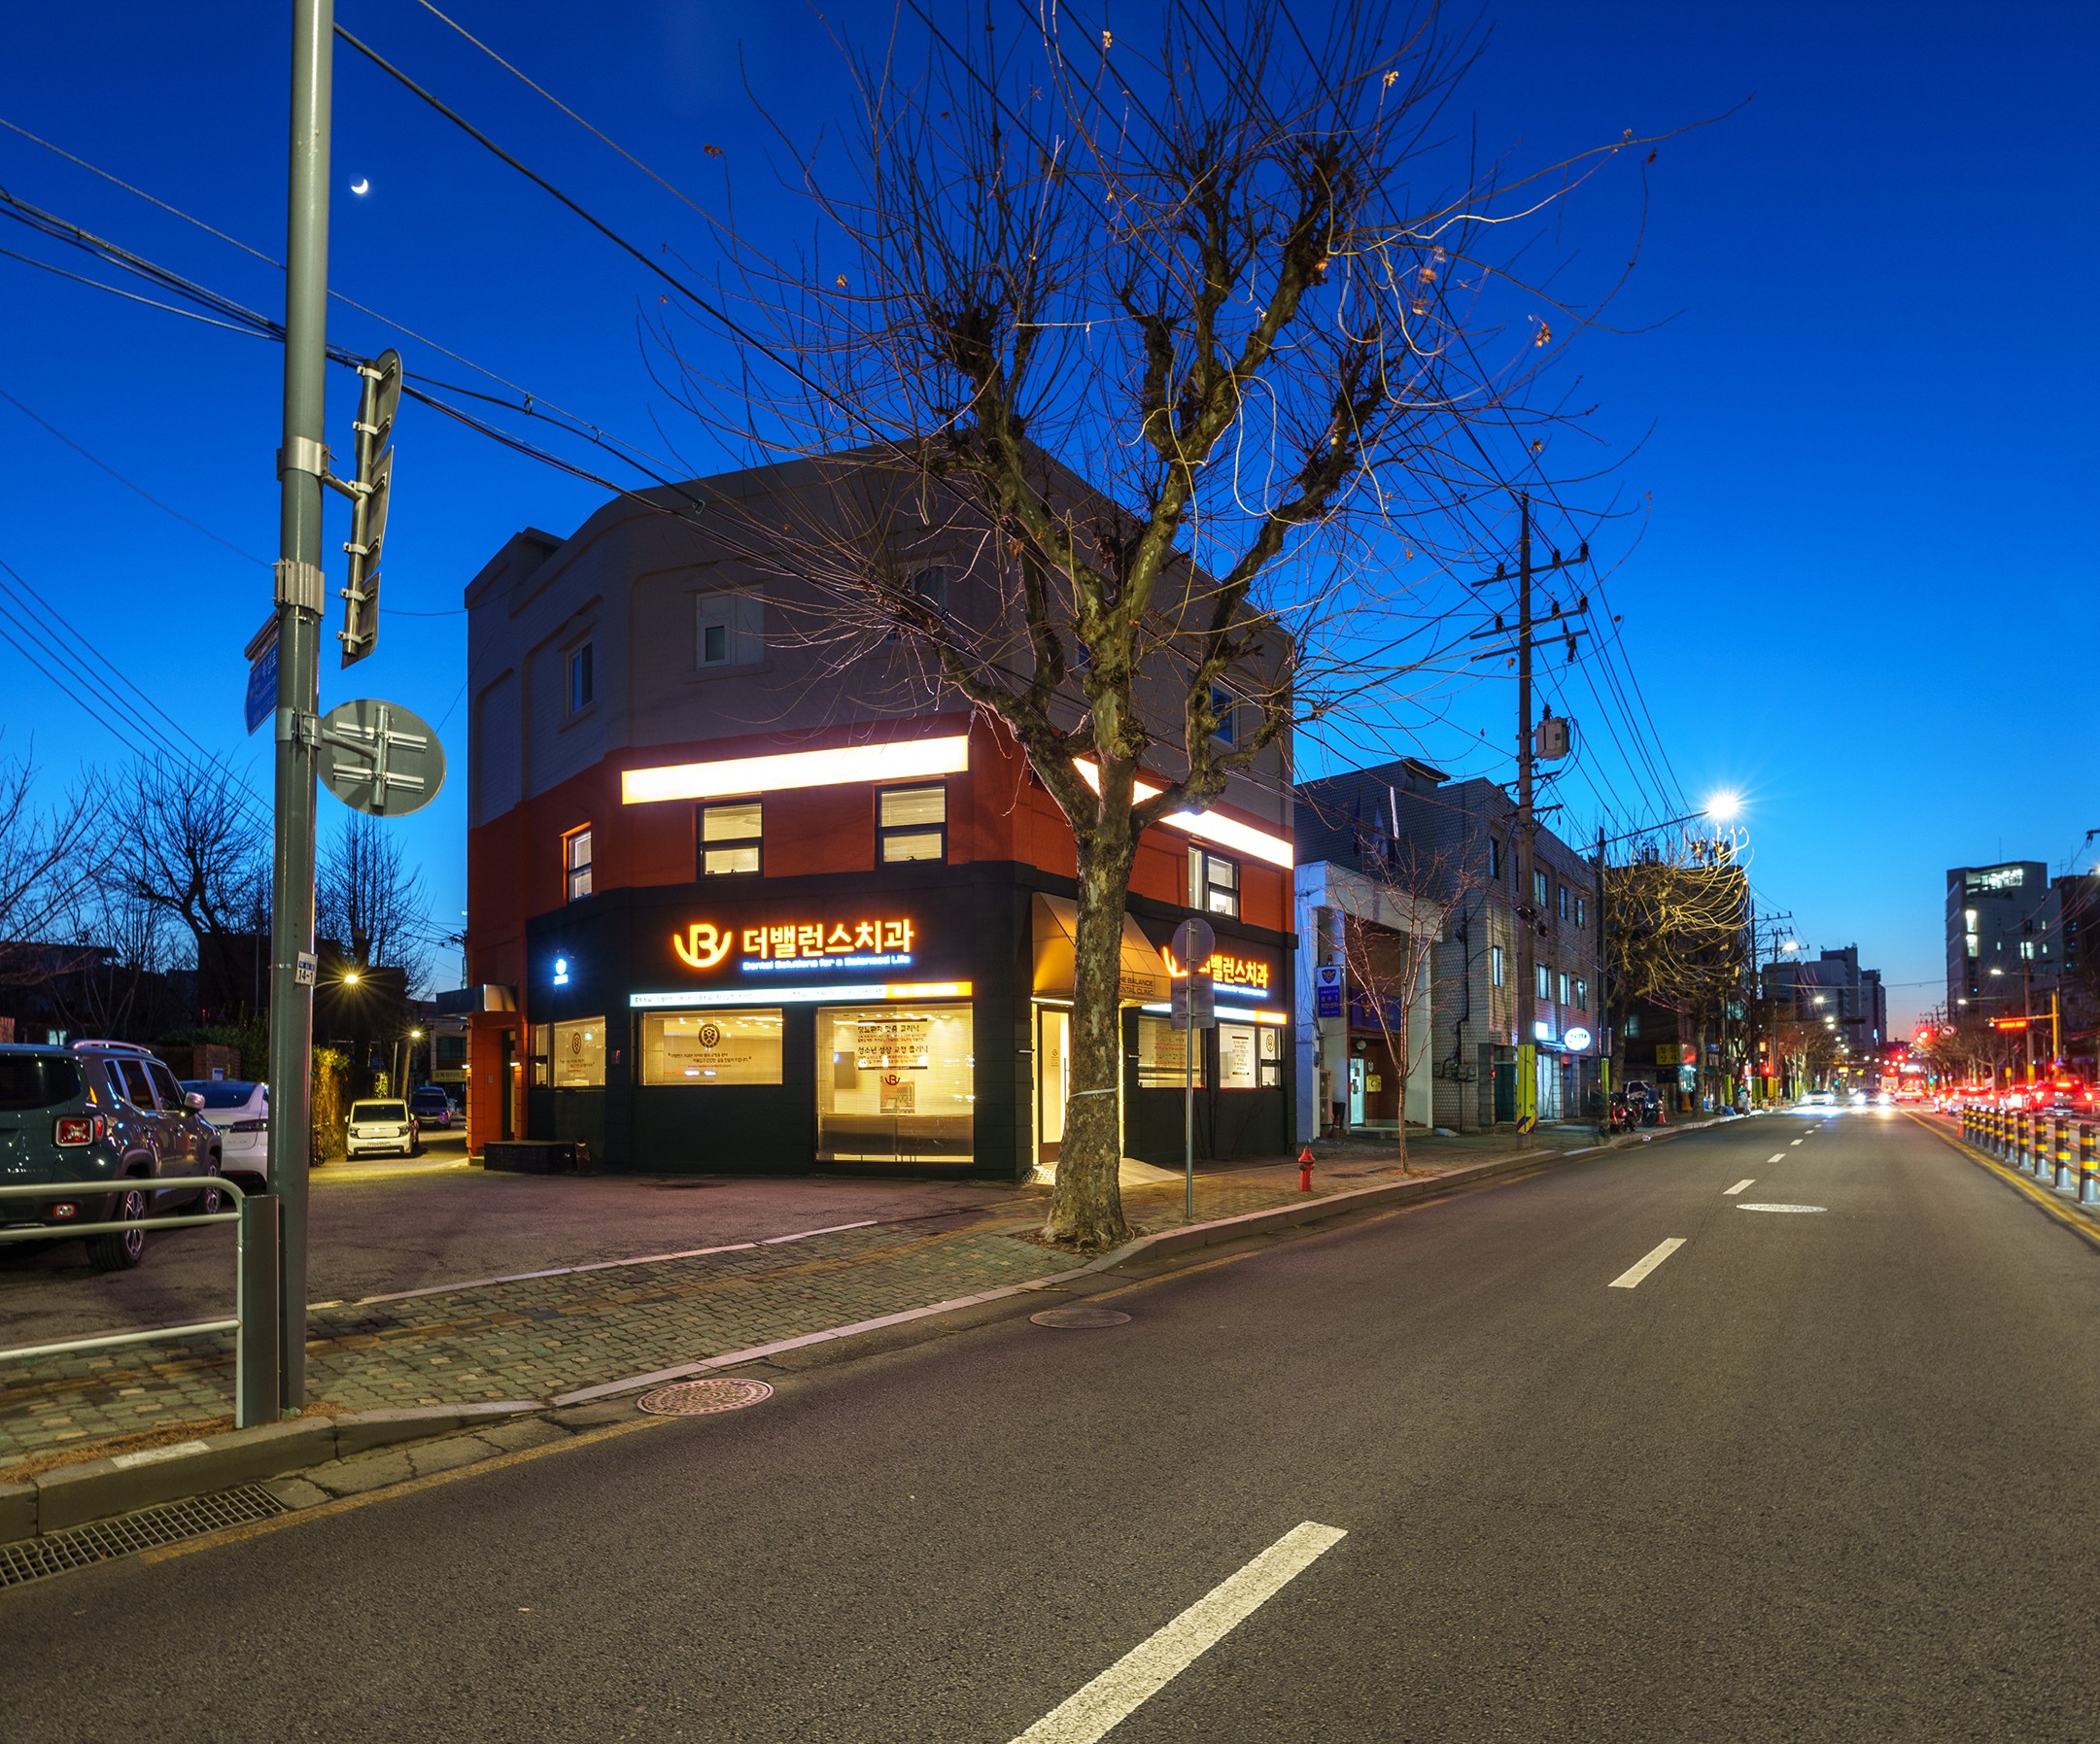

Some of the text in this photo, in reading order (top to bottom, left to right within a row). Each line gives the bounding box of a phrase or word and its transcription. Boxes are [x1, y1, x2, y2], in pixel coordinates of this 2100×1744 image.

[743, 919, 914, 960] 더밸런스치과
[742, 954, 911, 972] Dental Solutions for a Balanced Life
[299, 970, 314, 983] 14-1
[1127, 976, 1153, 987] BALANCE
[1136, 987, 1154, 996] CLINIC
